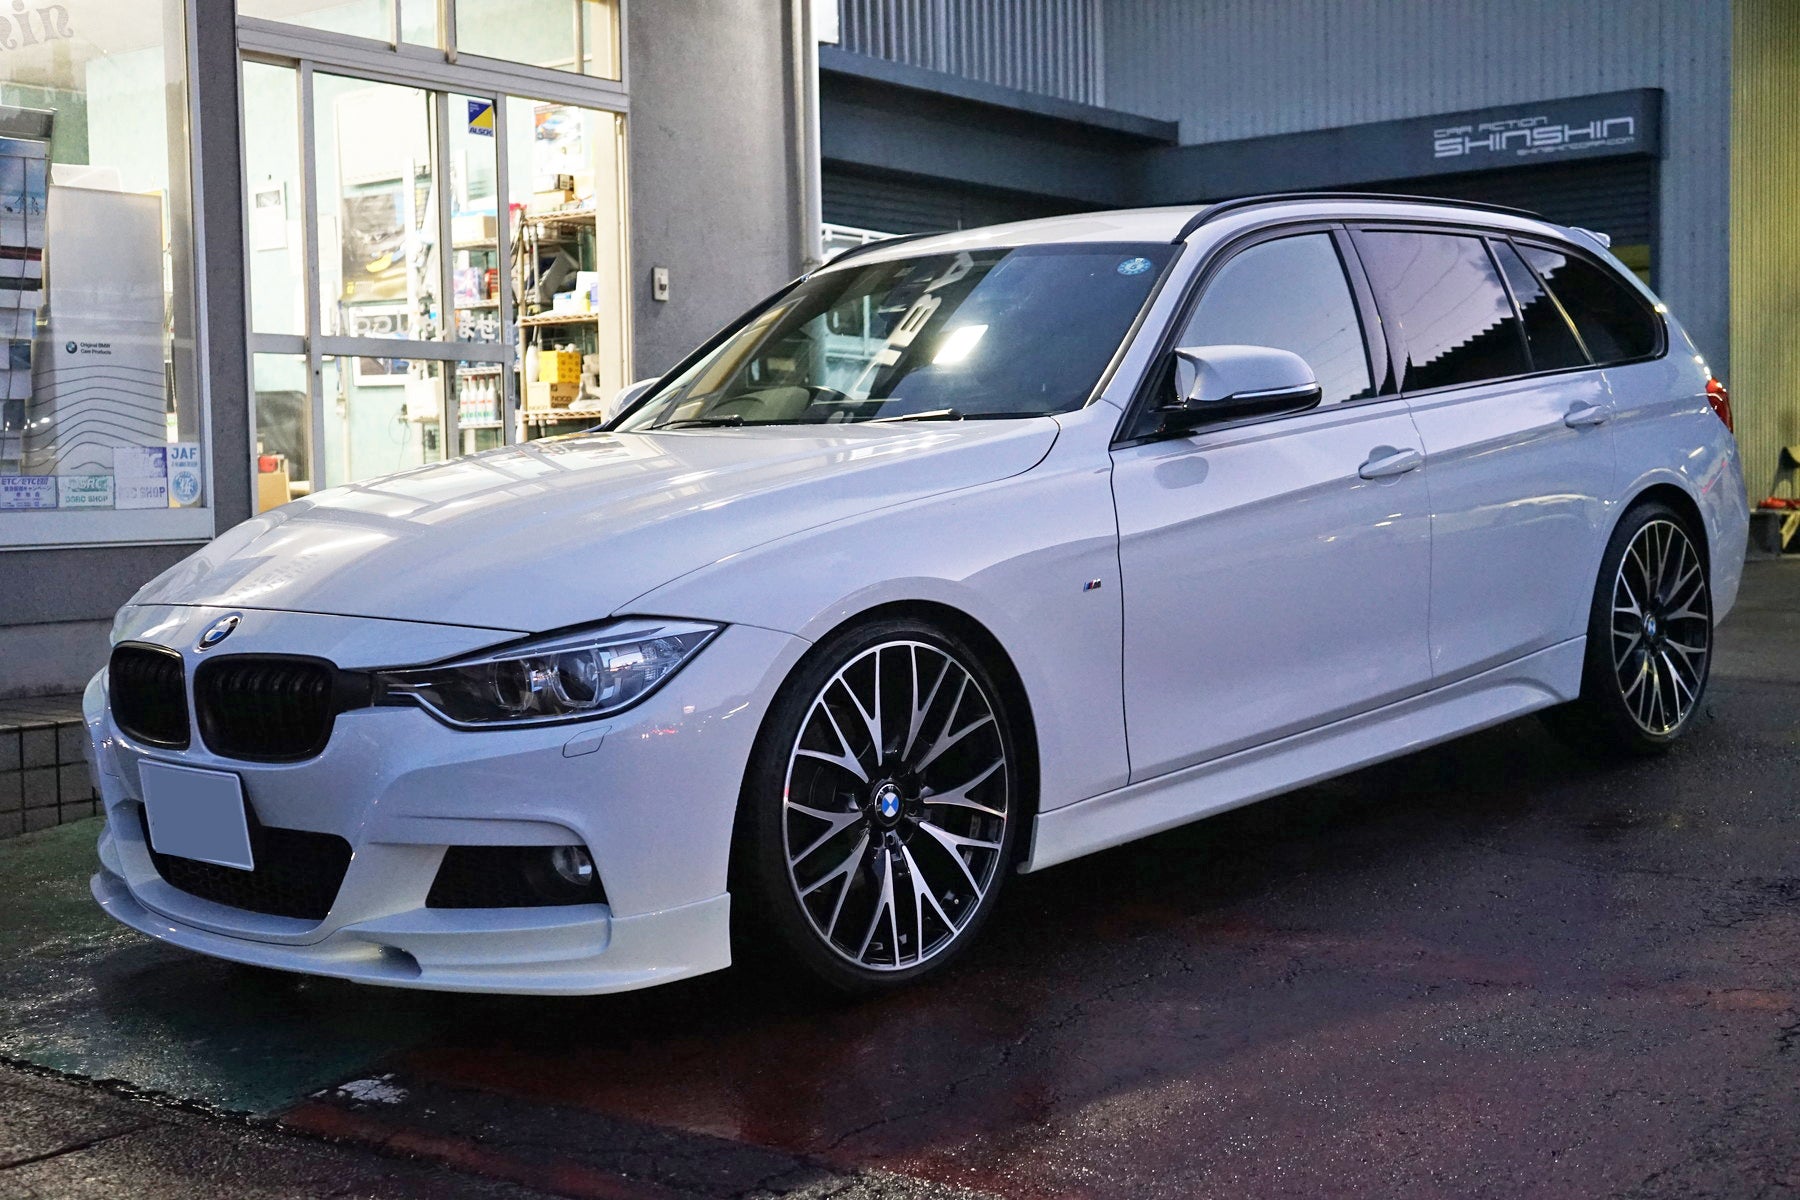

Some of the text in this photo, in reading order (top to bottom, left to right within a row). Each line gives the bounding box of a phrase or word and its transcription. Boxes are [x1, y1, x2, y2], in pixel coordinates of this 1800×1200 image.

[469, 127, 494, 137] ALSOK
[1434, 116, 1548, 138] CAR ACTION
[171, 447, 197, 459] JAF
